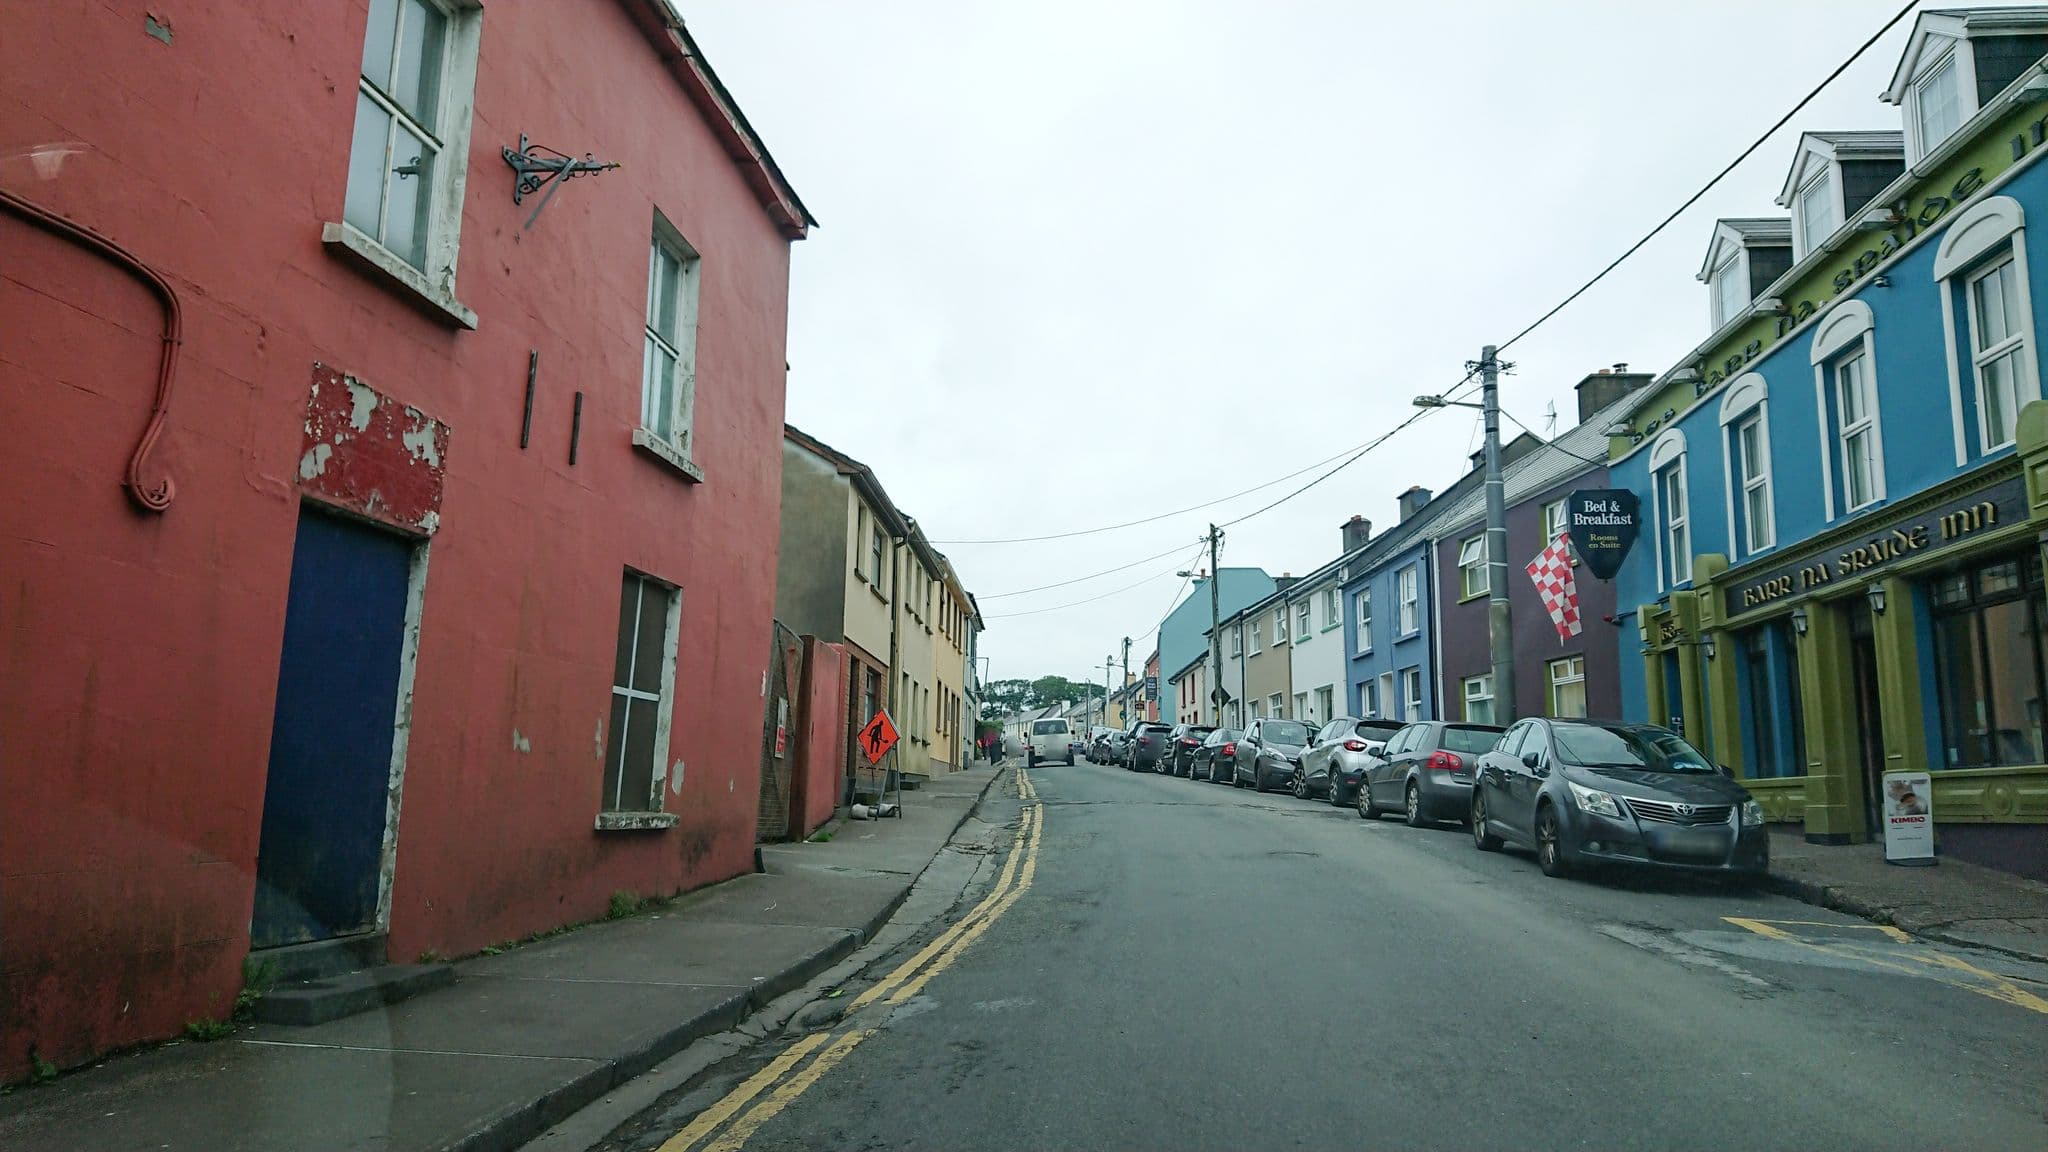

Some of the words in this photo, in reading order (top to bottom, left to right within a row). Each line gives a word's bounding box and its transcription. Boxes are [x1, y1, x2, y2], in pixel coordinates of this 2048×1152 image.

[1584, 500, 1607, 513] Bed
[1610, 500, 1621, 513] &
[1573, 513, 1633, 526] Breakfast
[1589, 533, 1619, 542] Rooms
[1600, 540, 1622, 549] Suite
